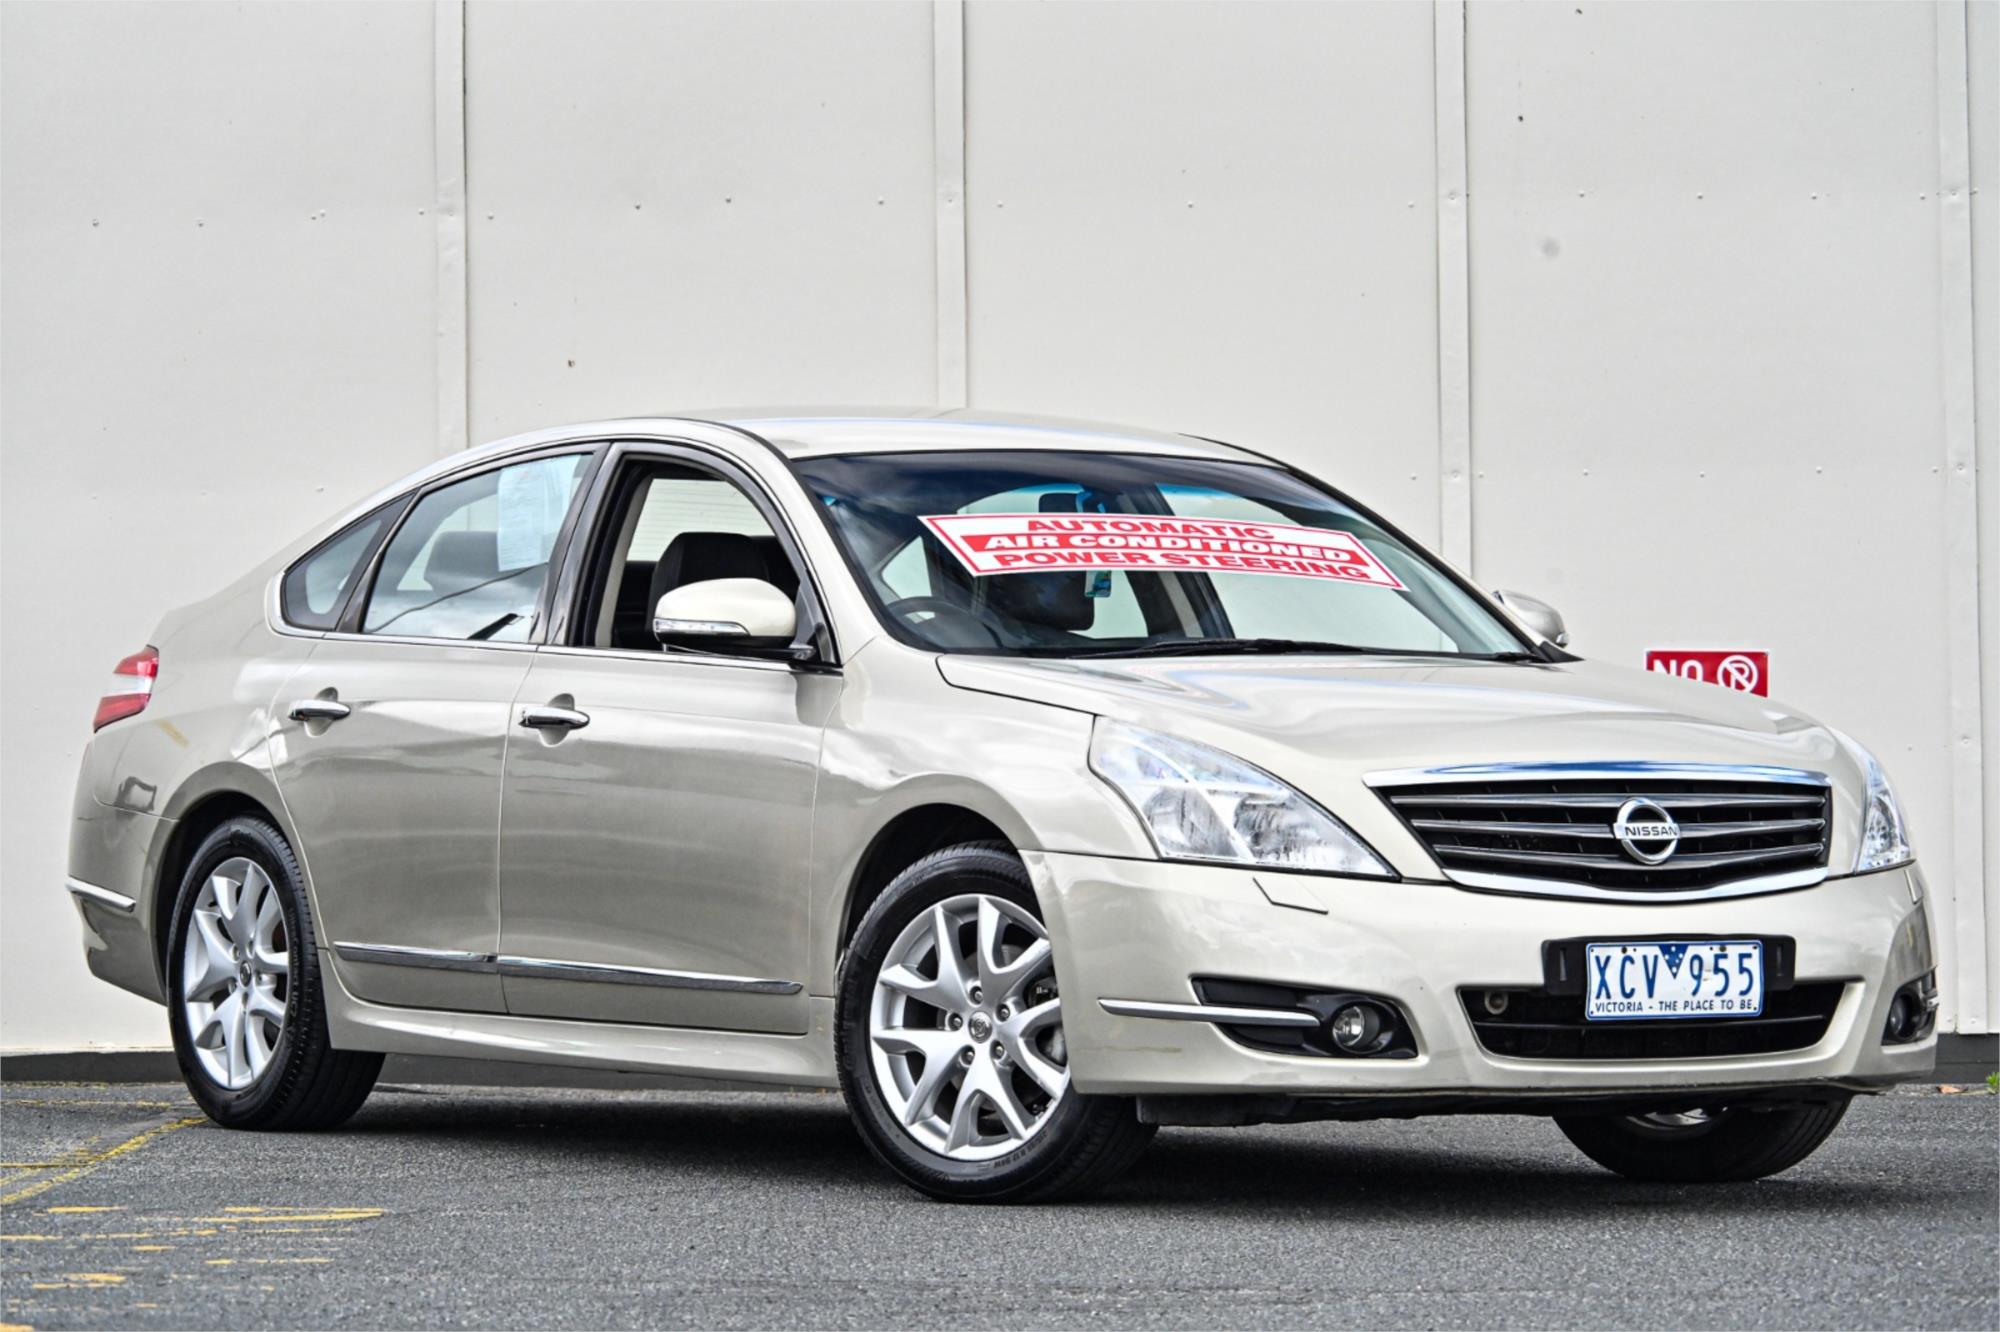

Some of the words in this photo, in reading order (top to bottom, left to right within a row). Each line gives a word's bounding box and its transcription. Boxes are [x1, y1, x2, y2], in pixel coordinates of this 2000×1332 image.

[1027, 520, 1275, 539] AUTOMATIC
[984, 535, 1059, 549] AIR
[1069, 535, 1351, 562] CONDITIONED
[993, 552, 1156, 566] POWER
[1160, 553, 1371, 580] STEERING
[1625, 826, 1678, 836] NISSAN
[1595, 954, 1658, 999] XCV
[1689, 953, 1754, 997] 955
[1595, 1001, 1643, 1013] VICTORIA
[1658, 1001, 1677, 1012] THE
[1683, 999, 1714, 1011] PLACE
[1720, 999, 1734, 1010] TO
[1739, 999, 1753, 1010] BE
